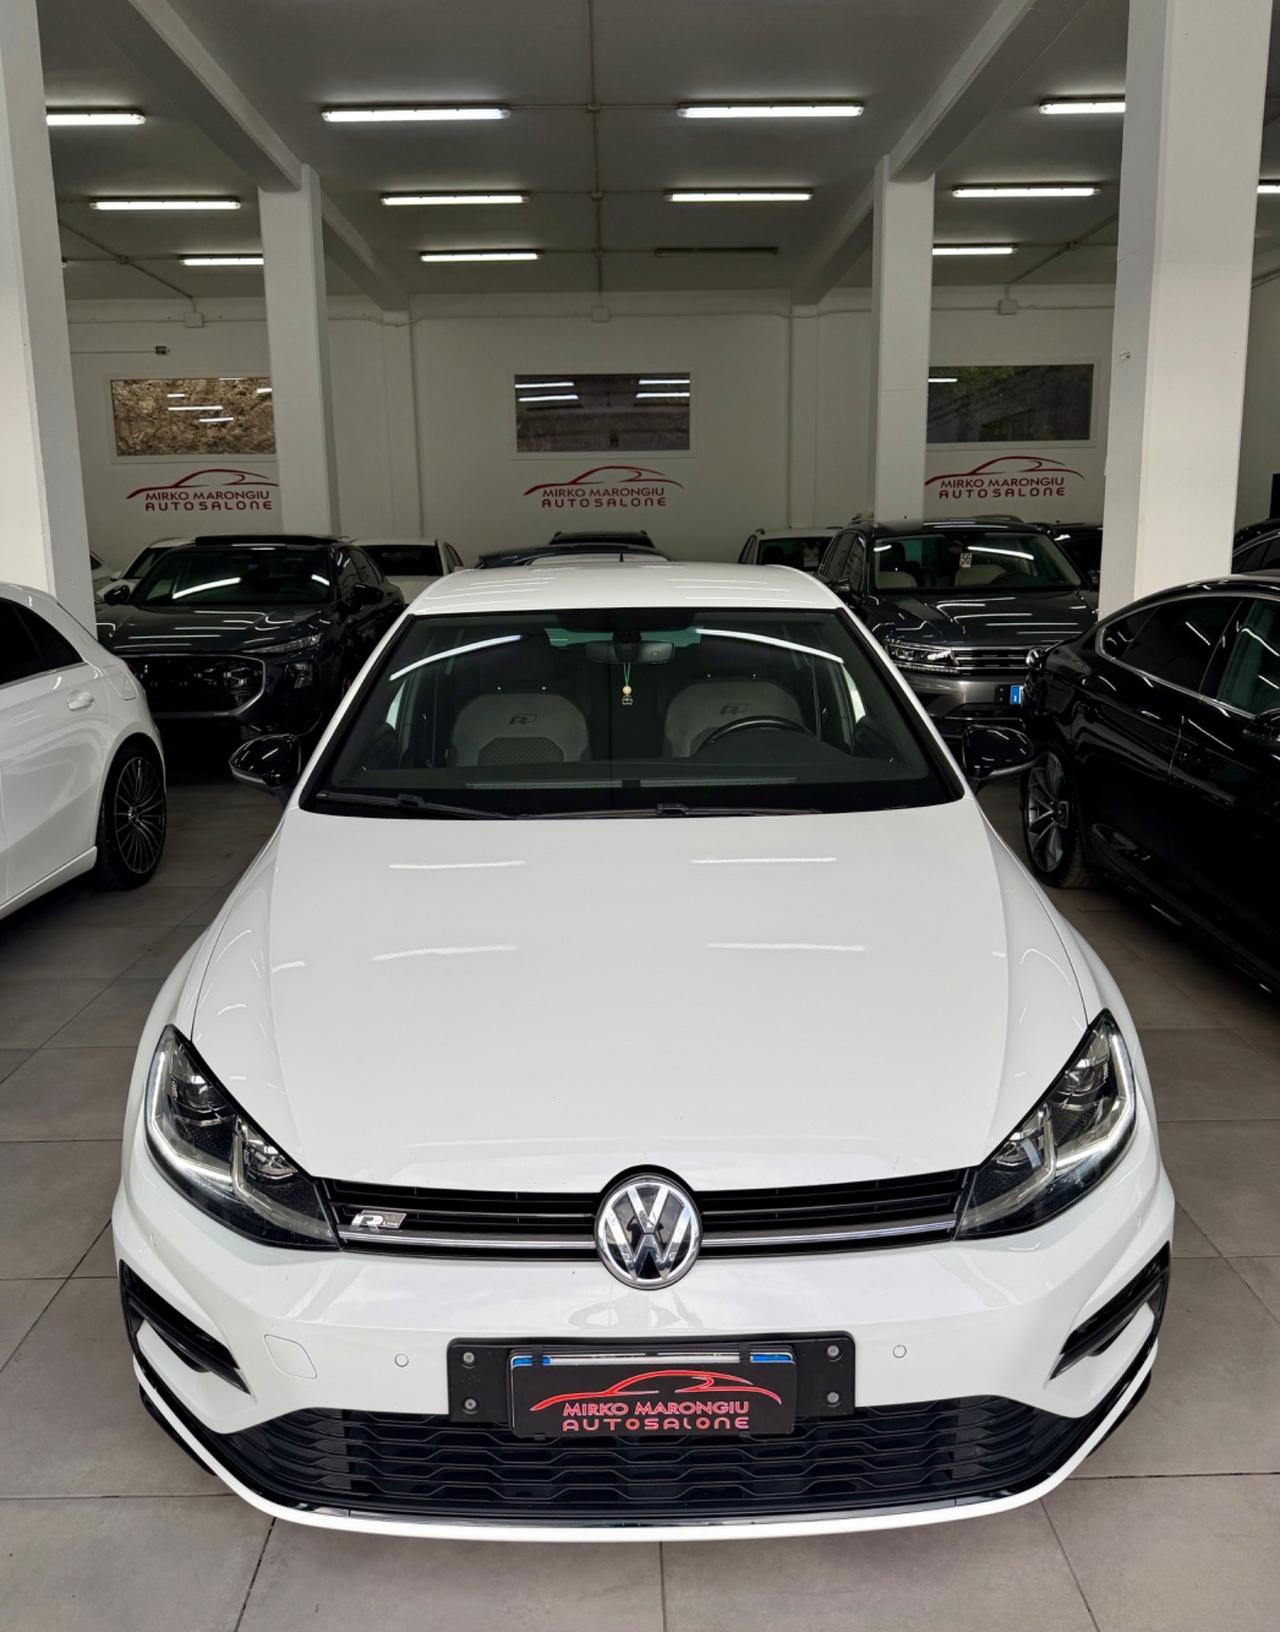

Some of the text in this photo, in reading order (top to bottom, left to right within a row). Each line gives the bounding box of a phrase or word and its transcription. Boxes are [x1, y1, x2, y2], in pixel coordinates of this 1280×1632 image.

[940, 477, 1064, 488] MIRKO MARONGIU
[145, 490, 269, 500] MIRKO MARONGIU
[542, 487, 664, 498] MIRKO MARONGIU
[939, 487, 1065, 499] AUTOSALONE
[145, 500, 272, 511] AUTOSALONE
[542, 497, 667, 508] AUTOSALONE
[562, 1400, 750, 1416] MIRKO MARONGIU
[562, 1416, 750, 1432] AUTOSALONE
